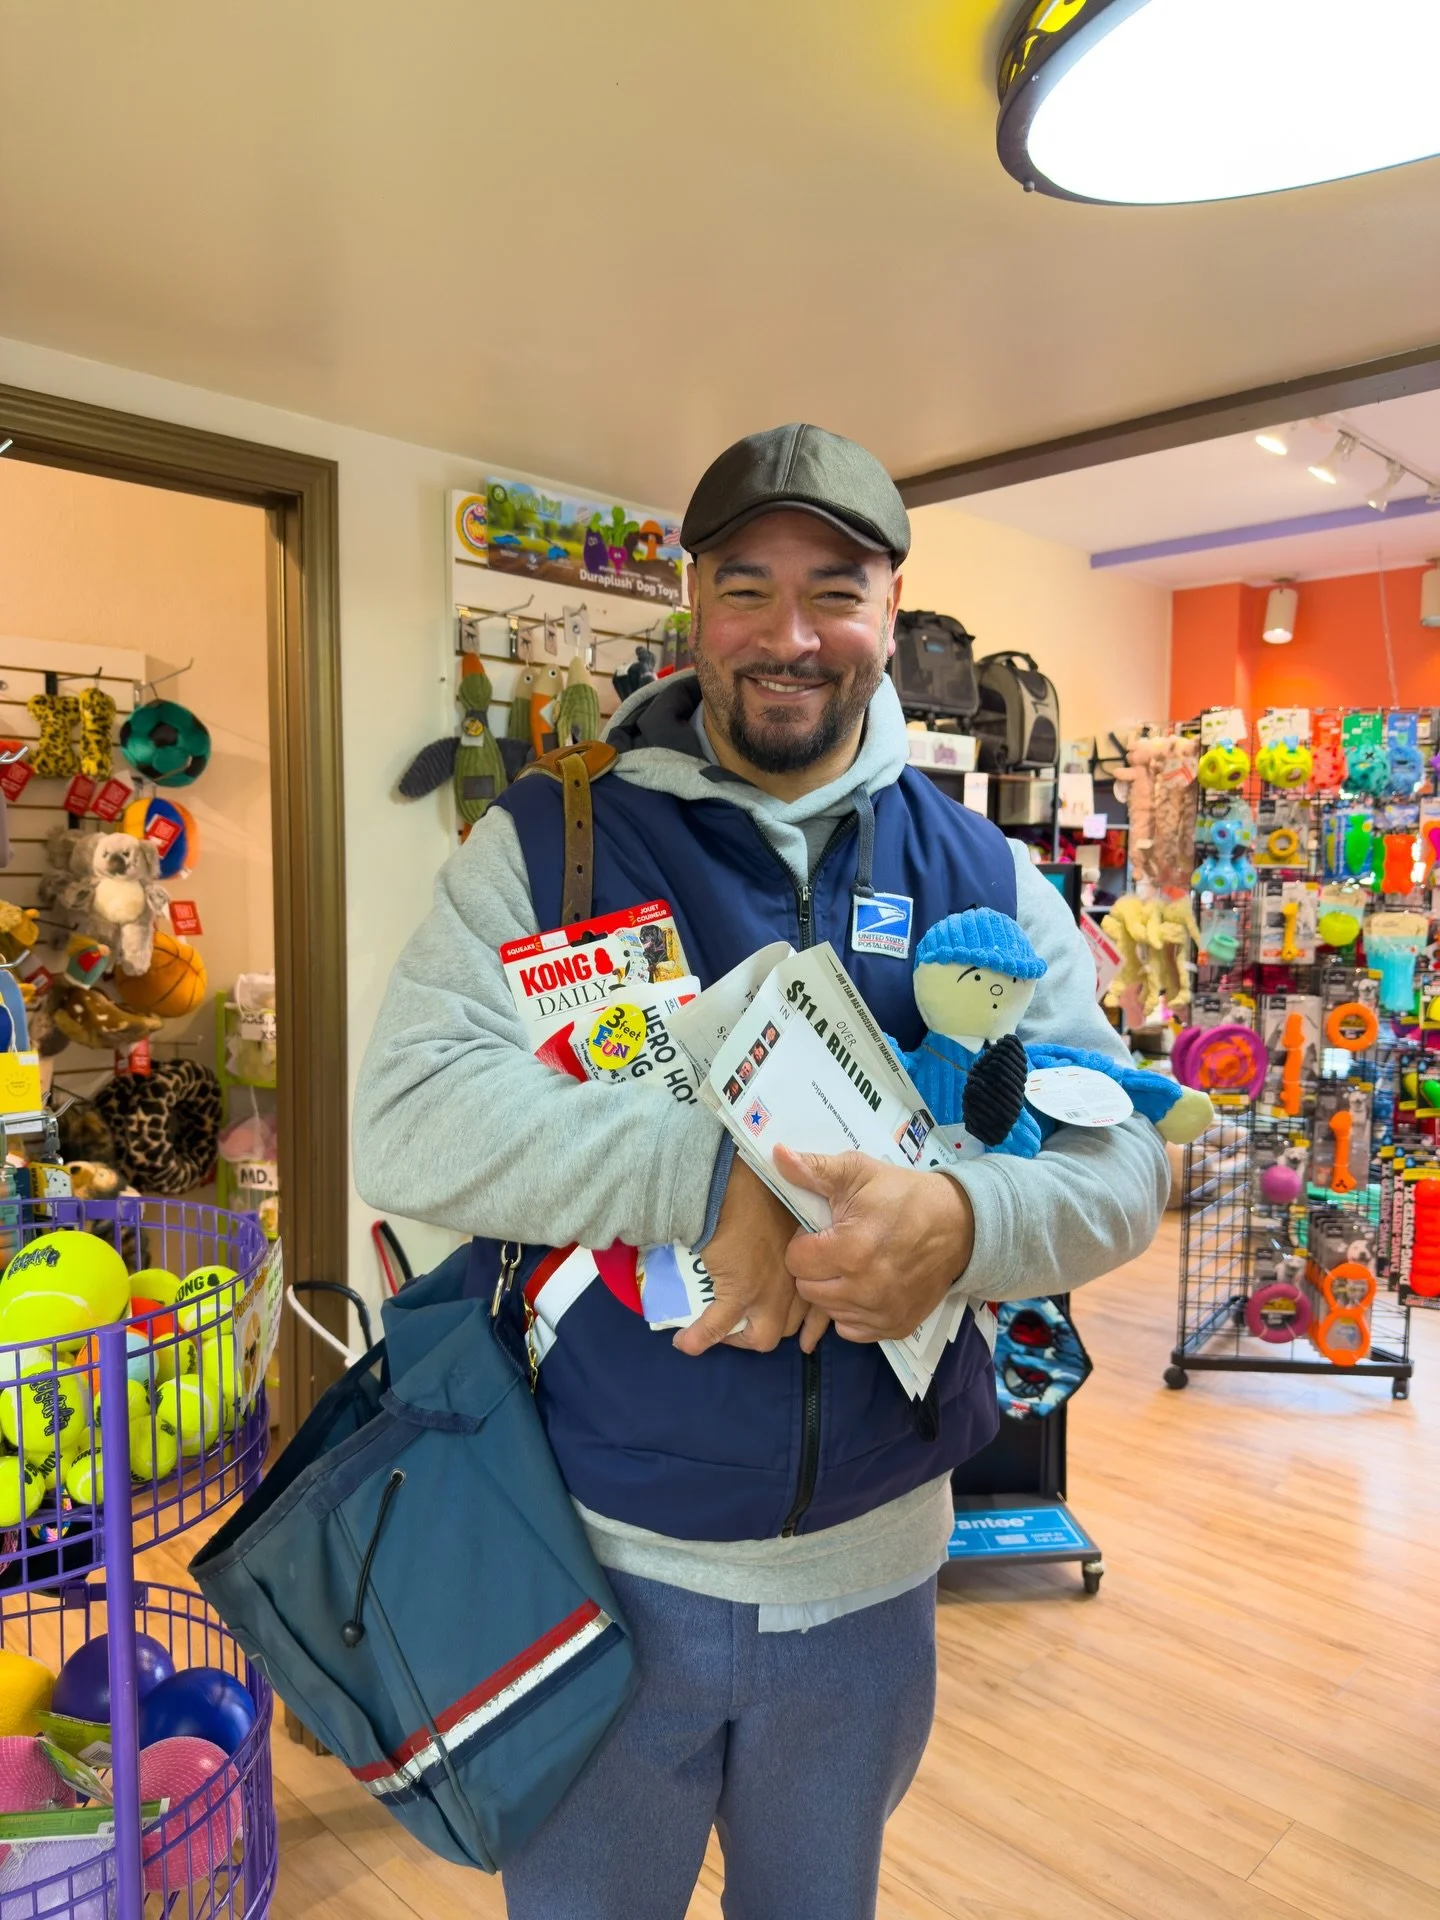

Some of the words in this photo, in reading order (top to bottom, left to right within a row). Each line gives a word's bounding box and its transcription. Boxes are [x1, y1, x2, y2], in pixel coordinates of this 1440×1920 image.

[636, 581, 656, 596] Dog
[658, 584, 679, 599] Toys
[637, 910, 667, 923] COUINEUR
[641, 904, 659, 914] JOUET
[507, 943, 535, 956] SQUEAKS
[883, 944, 905, 954] SERVICE
[885, 936, 904, 945] STATES
[519, 953, 592, 997] KONG
[537, 979, 607, 1016] DAILY
[780, 1005, 790, 1020] IN
[836, 973, 846, 986] OUR
[843, 983, 855, 999] TEAM
[851, 998, 861, 1010] HAS
[857, 1008, 881, 1043] SUCCESSFULLY
[878, 1042, 899, 1072] TRANSACTED
[606, 1007, 625, 1028] 3
[619, 1020, 641, 1041] feet
[642, 1005, 676, 1063] HERO
[836, 1021, 857, 1047] OVER
[593, 1024, 630, 1059] FUN
[615, 1031, 622, 1039] of
[811, 1080, 829, 1105] Notice
[827, 1103, 849, 1134] Renewal
[847, 1132, 861, 1150] Final
